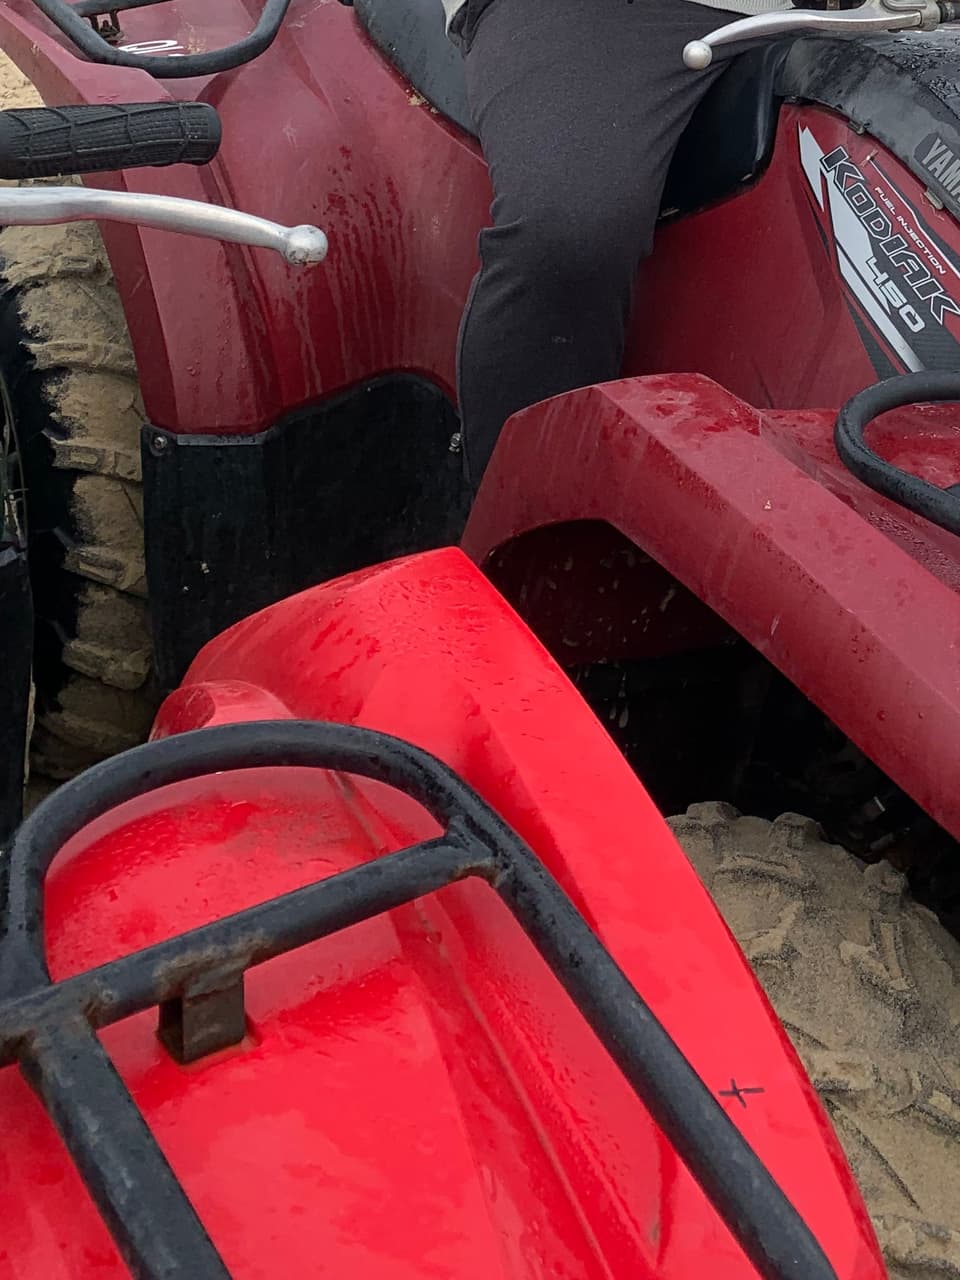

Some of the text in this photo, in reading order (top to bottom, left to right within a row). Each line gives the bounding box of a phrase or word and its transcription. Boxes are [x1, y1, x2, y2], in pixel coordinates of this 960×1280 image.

[874, 187, 947, 275] FUEL INJECTION
[866, 256, 926, 333] 450
